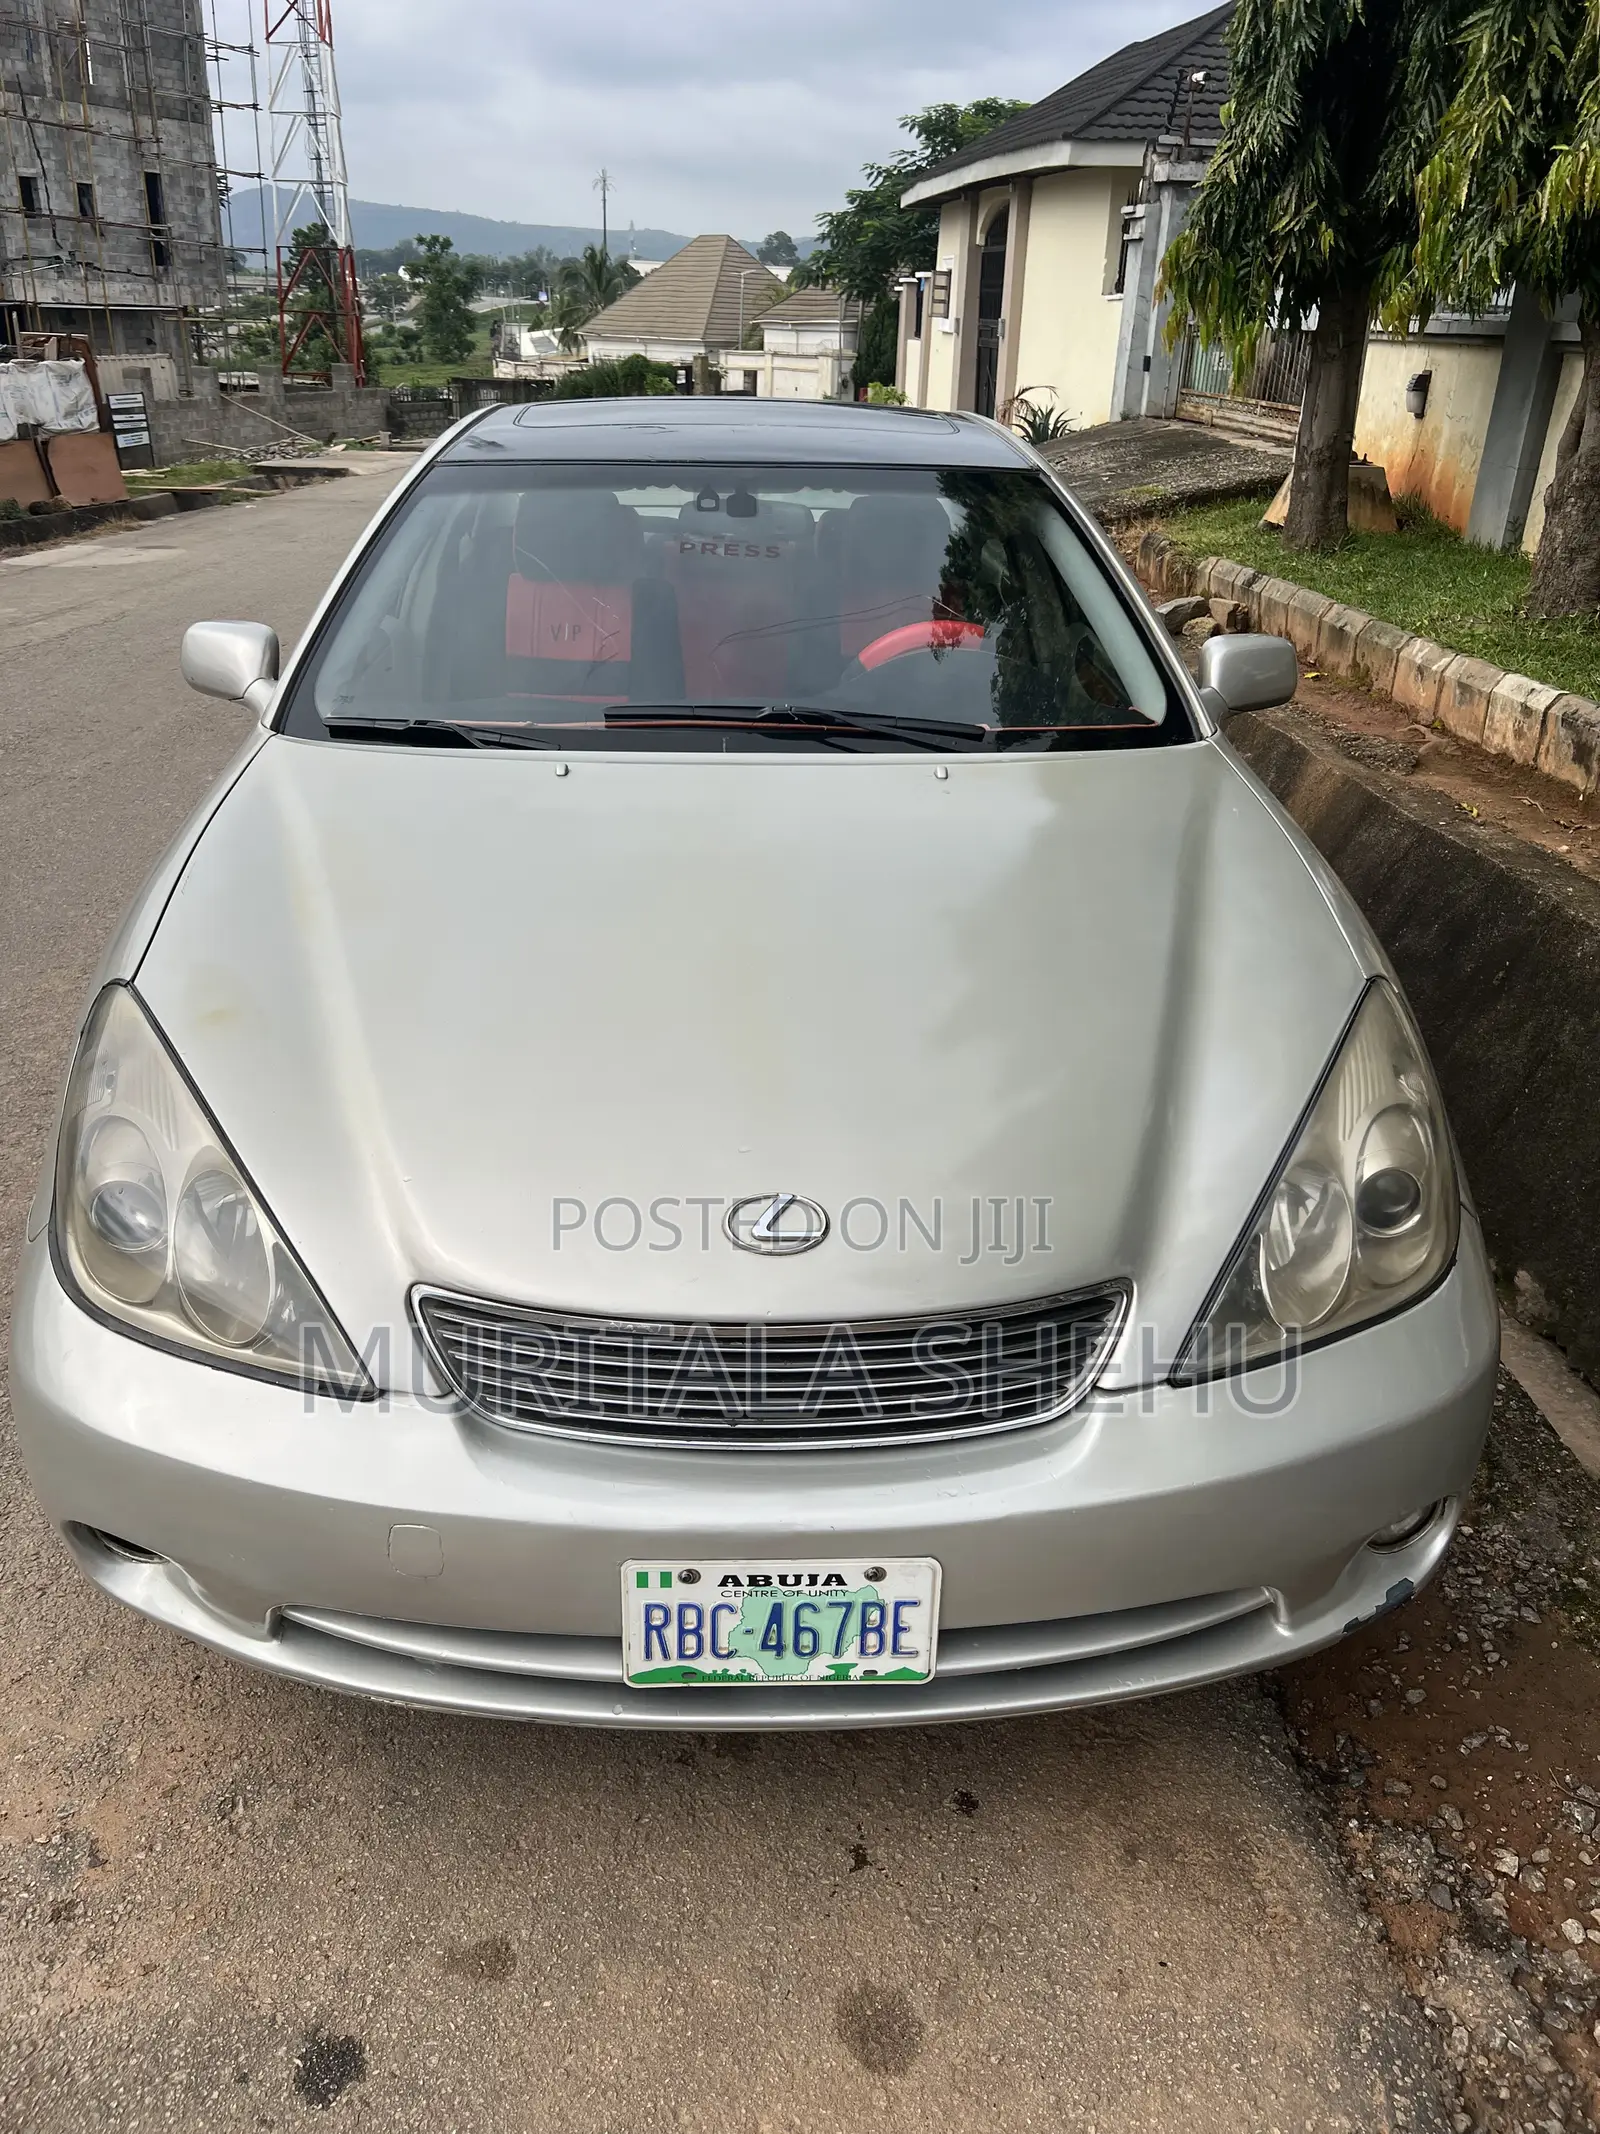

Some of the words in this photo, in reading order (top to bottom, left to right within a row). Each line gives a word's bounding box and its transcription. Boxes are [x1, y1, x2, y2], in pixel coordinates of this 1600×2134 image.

[680, 541, 780, 558] PRESS
[550, 623, 581, 641] VIP
[717, 1573, 848, 1587] ABUJA
[720, 1589, 779, 1598] CENTRE
[782, 1589, 804, 1598] OF
[808, 1588, 849, 1598] UNITY
[644, 1601, 920, 1660] RBC-467BE
